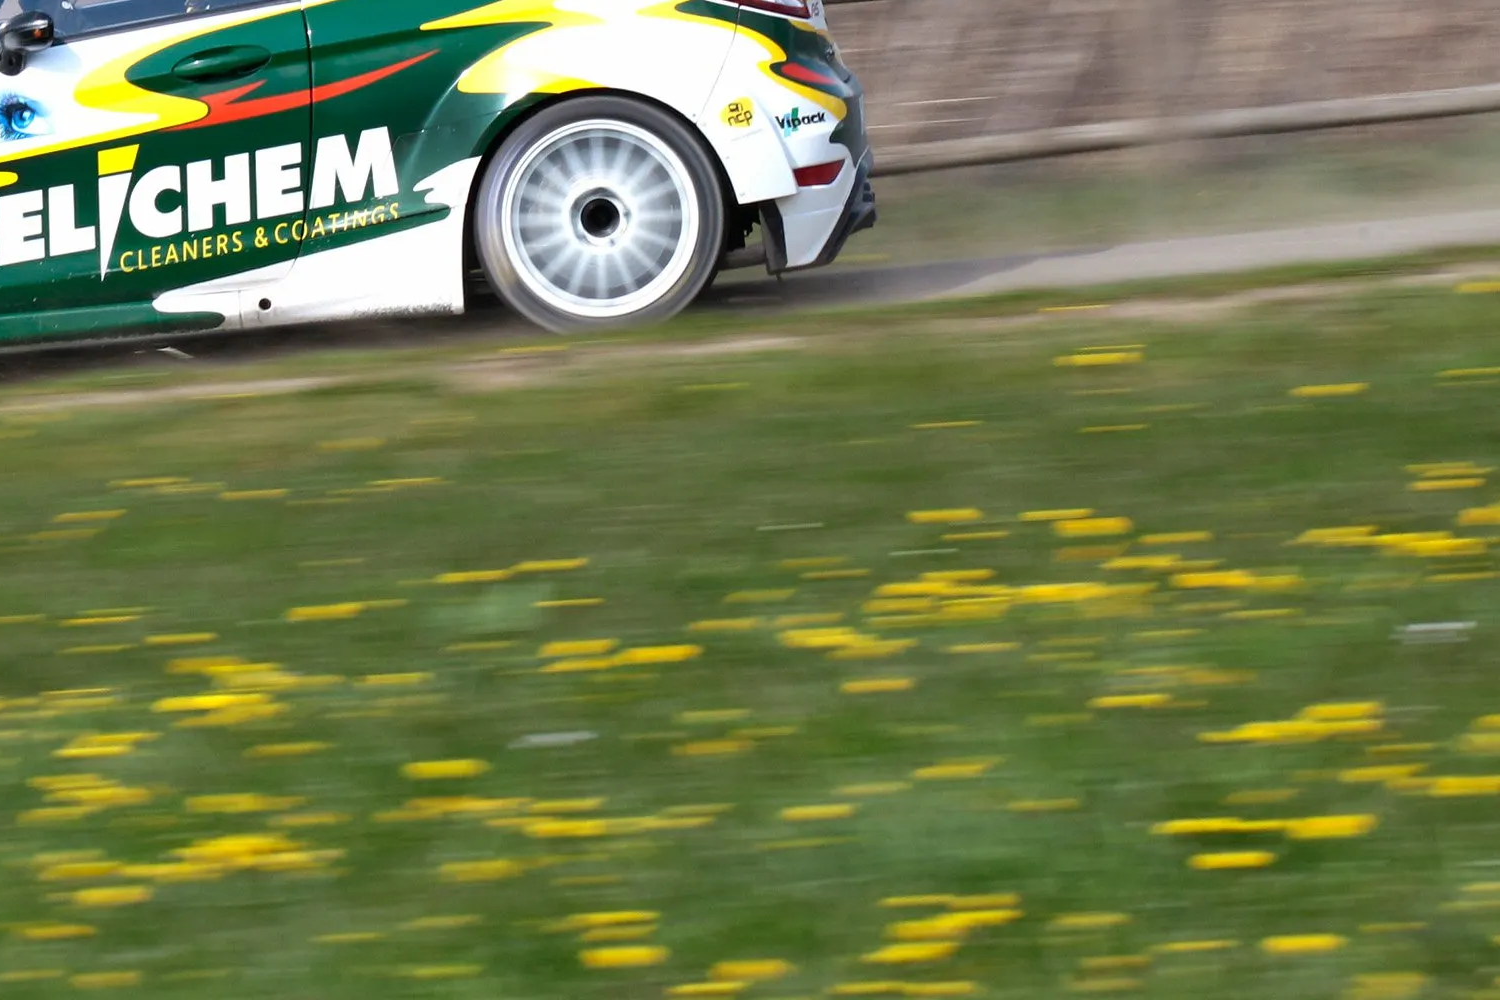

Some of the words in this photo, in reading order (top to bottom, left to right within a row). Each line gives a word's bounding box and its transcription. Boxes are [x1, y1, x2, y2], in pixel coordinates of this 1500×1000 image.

[775, 108, 826, 132] Vipack
[119, 230, 243, 273] CLEANERS
[254, 226, 268, 248] &
[274, 202, 399, 245] COATINGS
